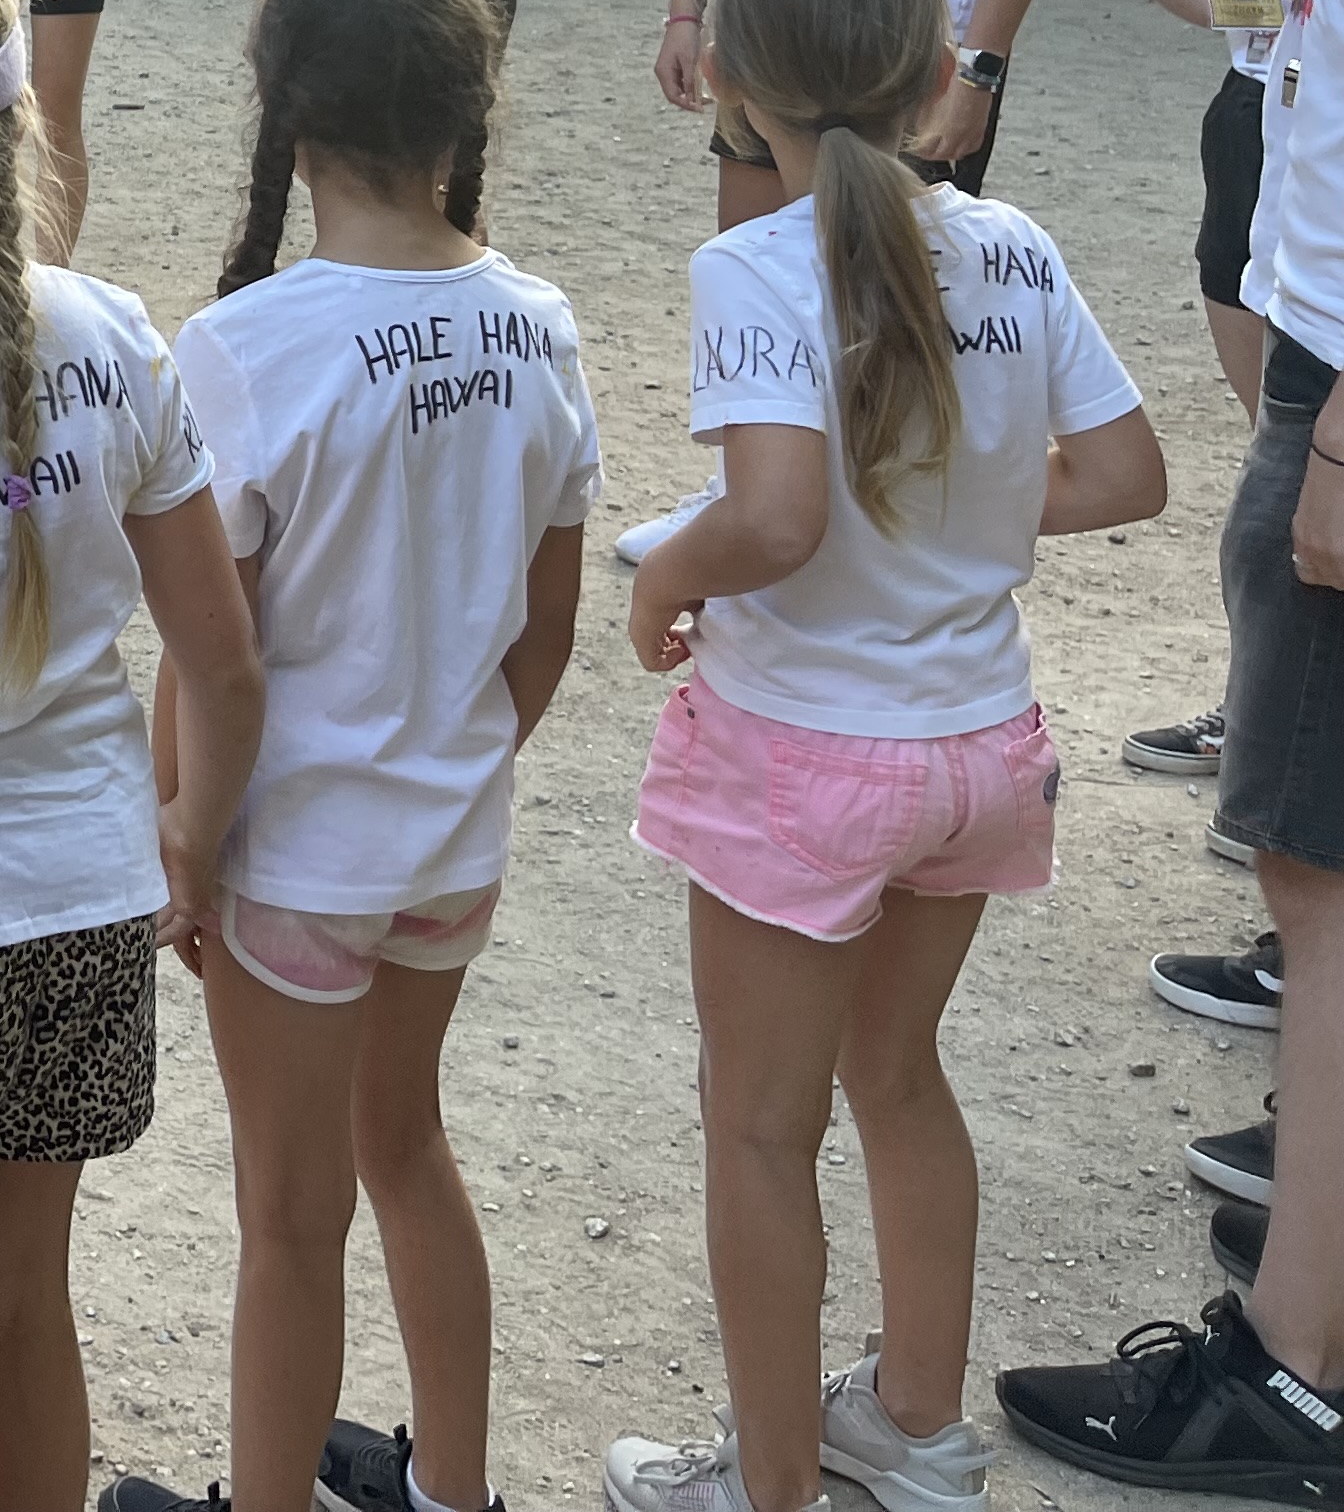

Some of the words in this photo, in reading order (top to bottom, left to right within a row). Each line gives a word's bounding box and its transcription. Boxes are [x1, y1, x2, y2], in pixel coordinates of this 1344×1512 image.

[354, 316, 453, 385] HALE
[478, 310, 554, 371] HANA
[693, 325, 819, 393] LAURA
[409, 368, 512, 435] HAWAI
[1265, 1368, 1342, 1432] PUMA
